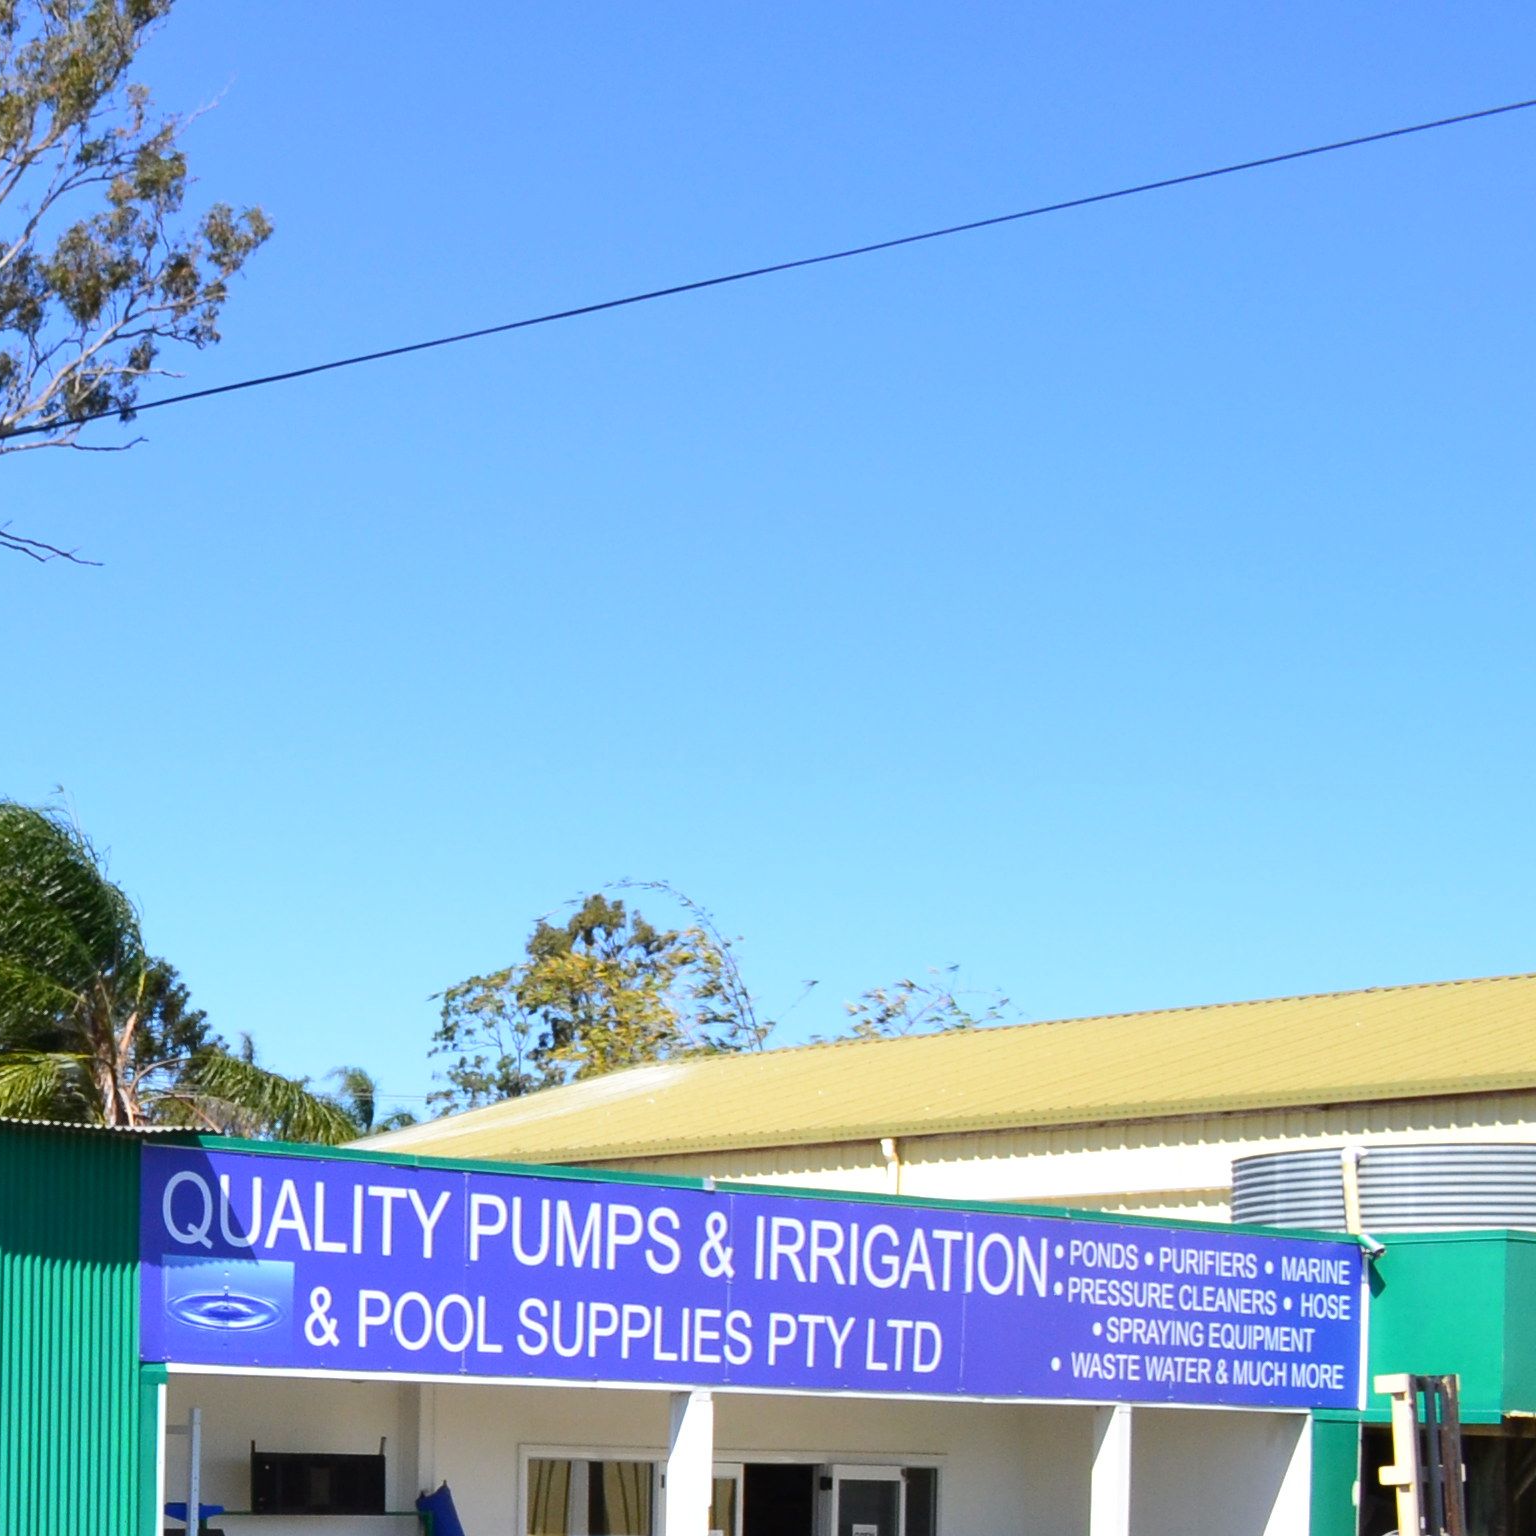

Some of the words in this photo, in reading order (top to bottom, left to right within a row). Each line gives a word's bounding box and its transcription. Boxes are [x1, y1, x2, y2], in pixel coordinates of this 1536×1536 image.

[162, 1171, 451, 1259] QUALITY
[469, 1193, 682, 1276] PUMPS
[699, 1210, 736, 1279] &
[755, 1215, 1047, 1298] IRRIGATION
[1069, 1240, 1139, 1271] PONDS
[1159, 1248, 1257, 1278] PURIFIERS
[1282, 1256, 1351, 1285] MARINE
[1068, 1281, 1175, 1311] PRESSURE
[1179, 1286, 1277, 1316] CLEANERS
[1301, 1293, 1351, 1321] HOSE
[305, 1285, 341, 1347] &
[357, 1290, 503, 1355] POOL
[517, 1297, 753, 1365] SUPPLIES
[767, 1312, 854, 1369] PTY
[866, 1318, 942, 1373] LTD
[1106, 1322, 1204, 1350] SPRAYING
[1209, 1324, 1315, 1353] EQUIPMENT
[1072, 1352, 1139, 1381] WASTE
[1146, 1356, 1211, 1384] WATER
[1216, 1360, 1229, 1385] &
[1233, 1360, 1287, 1388] MUCH
[1291, 1363, 1344, 1389] MORE
